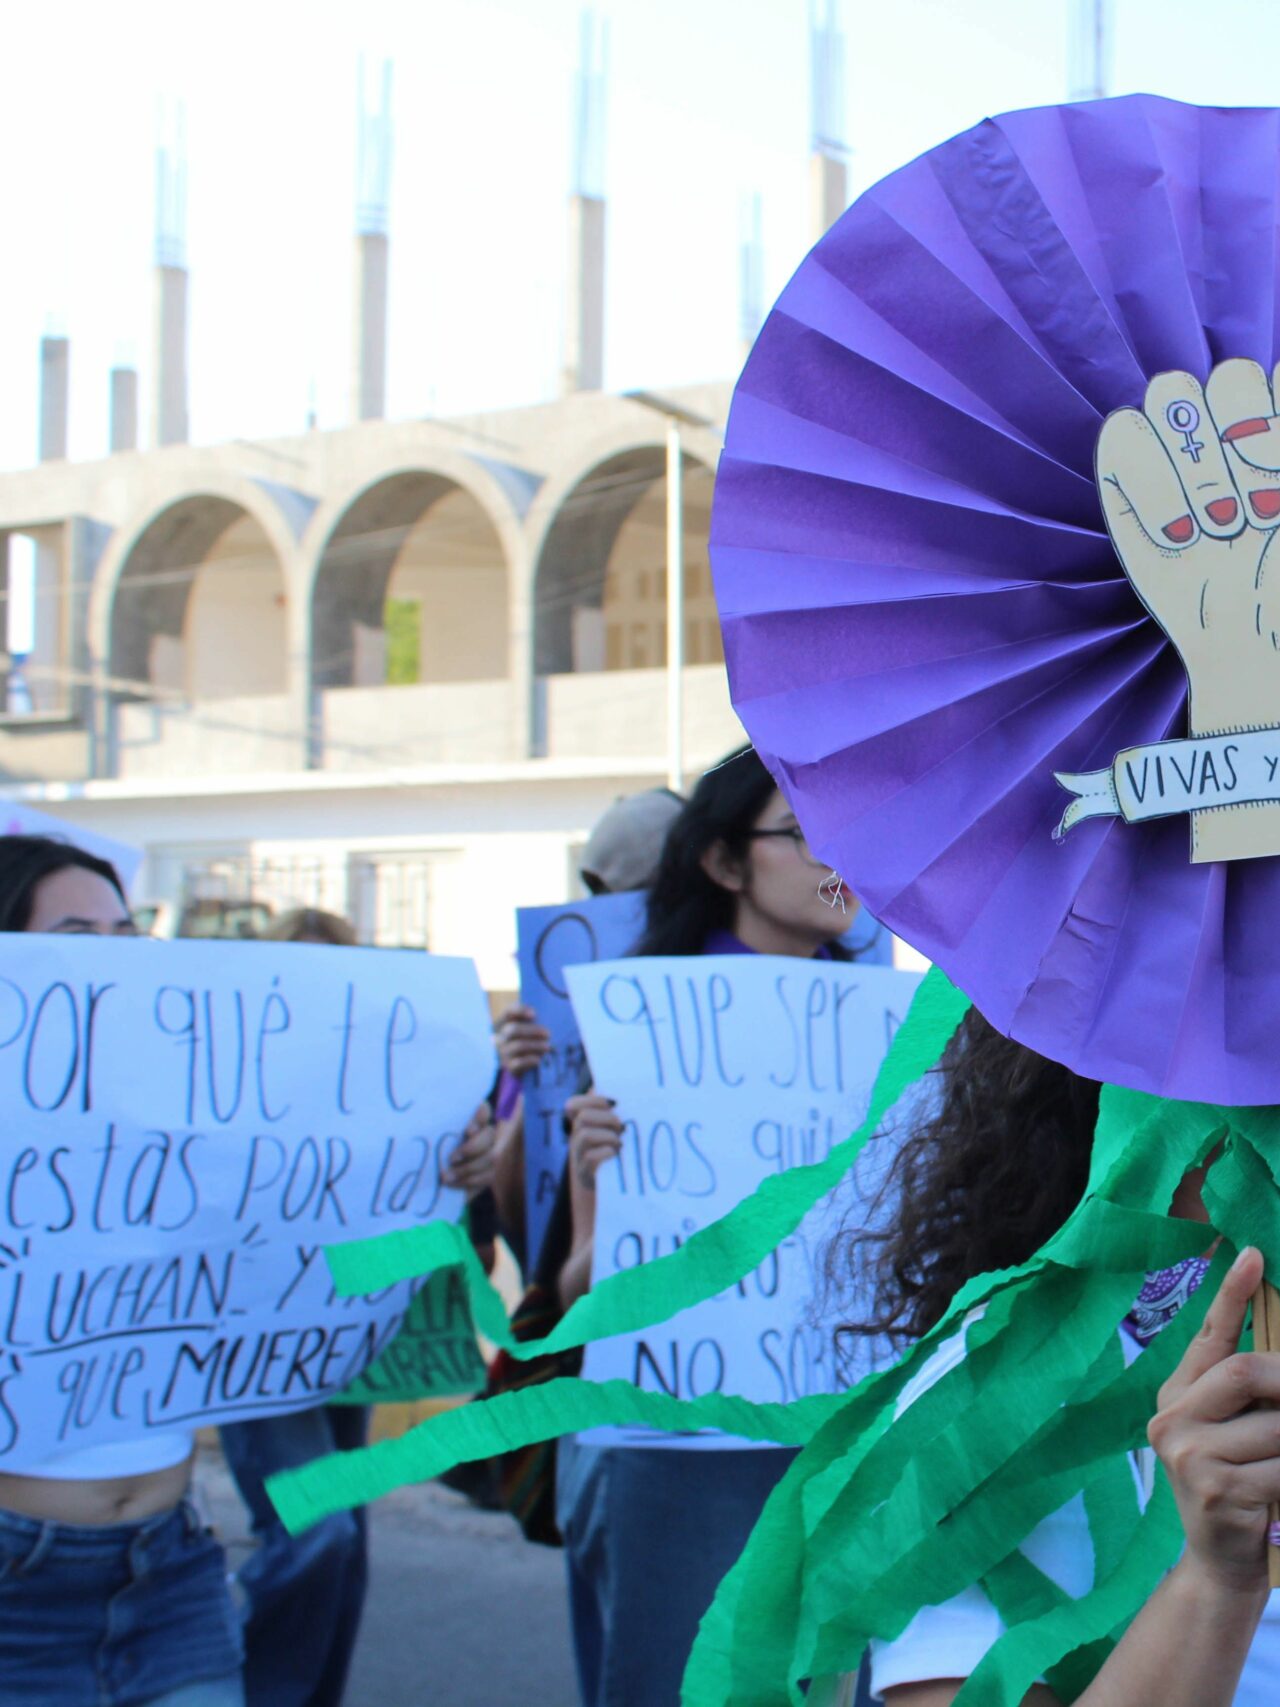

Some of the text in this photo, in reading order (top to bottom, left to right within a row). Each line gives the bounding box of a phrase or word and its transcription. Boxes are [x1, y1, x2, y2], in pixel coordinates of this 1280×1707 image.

[1125, 745, 1239, 804] VIVAS
[331, 981, 418, 1116] te
[233, 1134, 354, 1227] POR
[5, 1248, 238, 1348] LUCHAN
[160, 1322, 402, 1409] MUEREN
